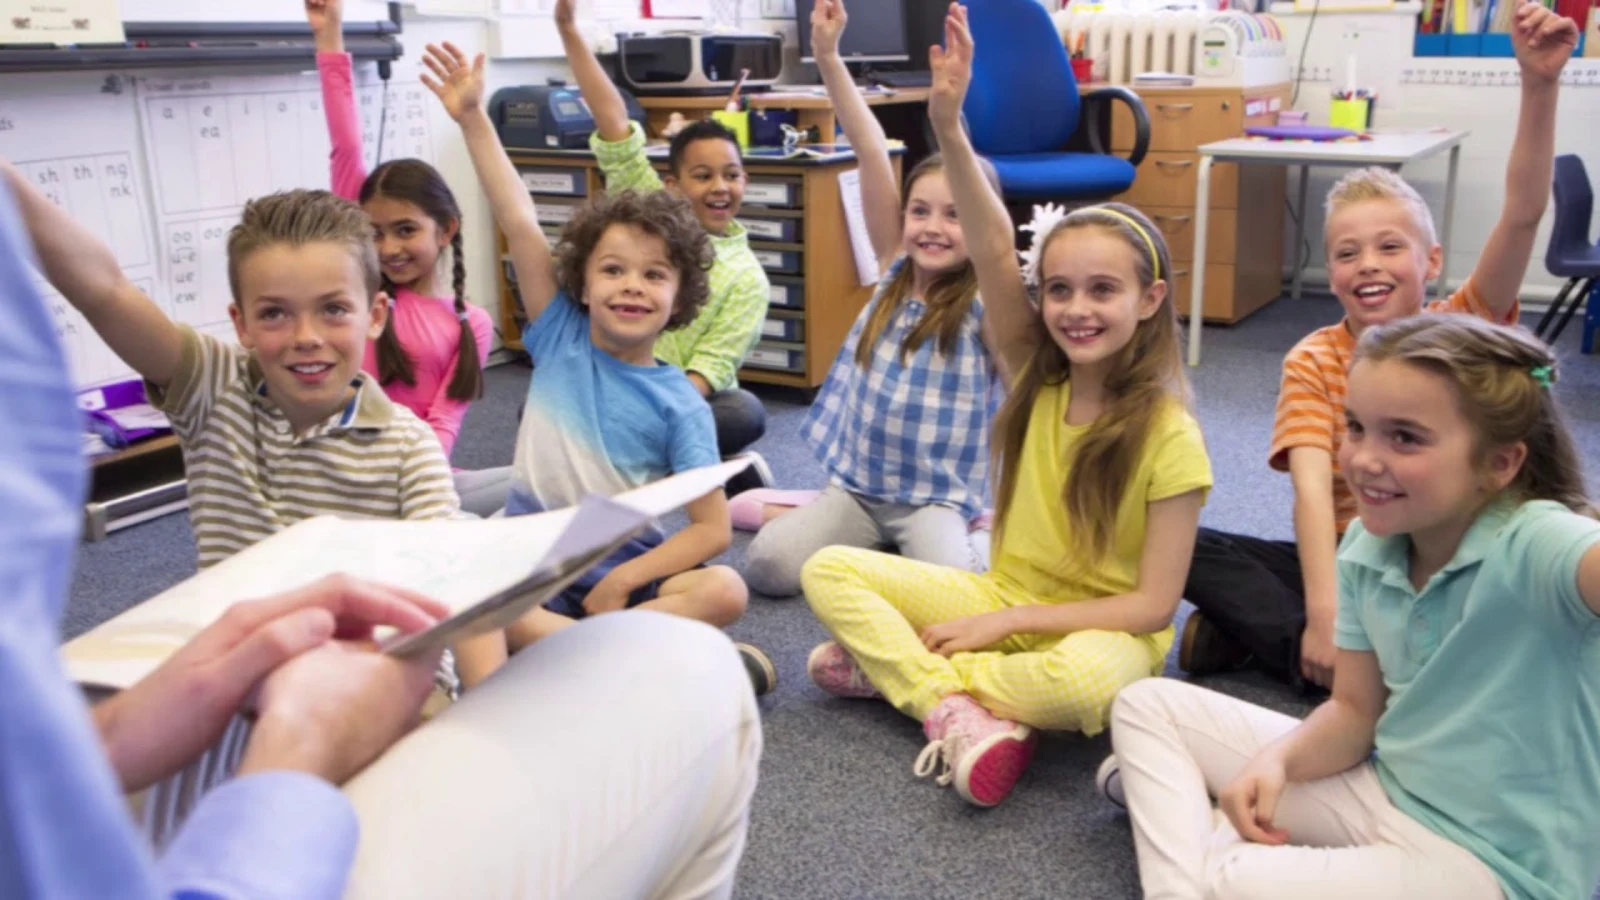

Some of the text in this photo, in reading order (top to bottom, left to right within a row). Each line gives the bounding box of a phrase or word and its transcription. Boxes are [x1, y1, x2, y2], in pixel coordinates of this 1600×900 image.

[162, 107, 173, 120] a
[203, 105, 213, 118] e
[200, 126, 220, 139] ea
[37, 166, 60, 185] sh
[73, 164, 93, 180] th
[172, 231, 193, 243] oo
